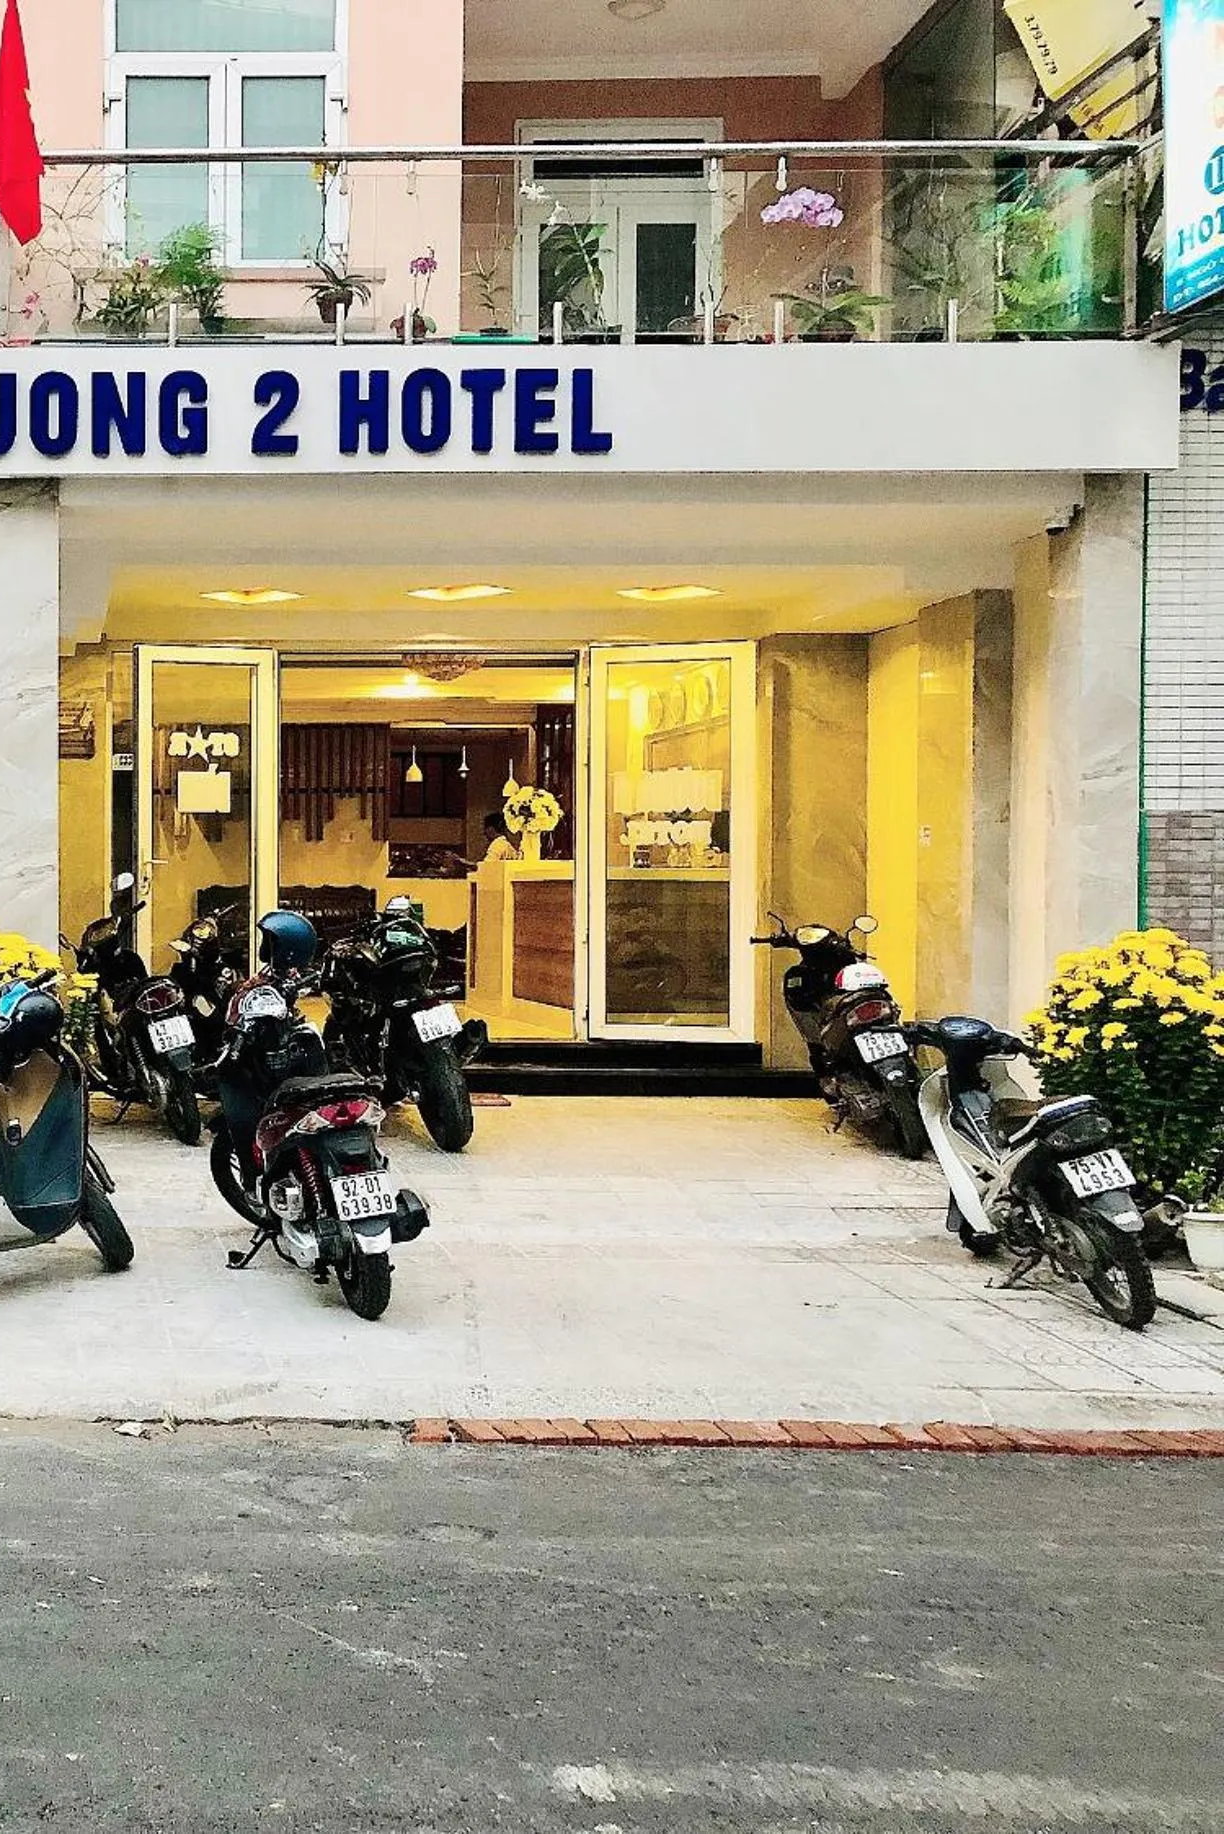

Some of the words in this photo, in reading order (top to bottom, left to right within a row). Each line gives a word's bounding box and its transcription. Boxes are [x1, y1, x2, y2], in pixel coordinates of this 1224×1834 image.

[251, 369, 300, 457] 2
[339, 367, 612, 457] HOTEL
[340, 1194, 394, 1218] 639.38
